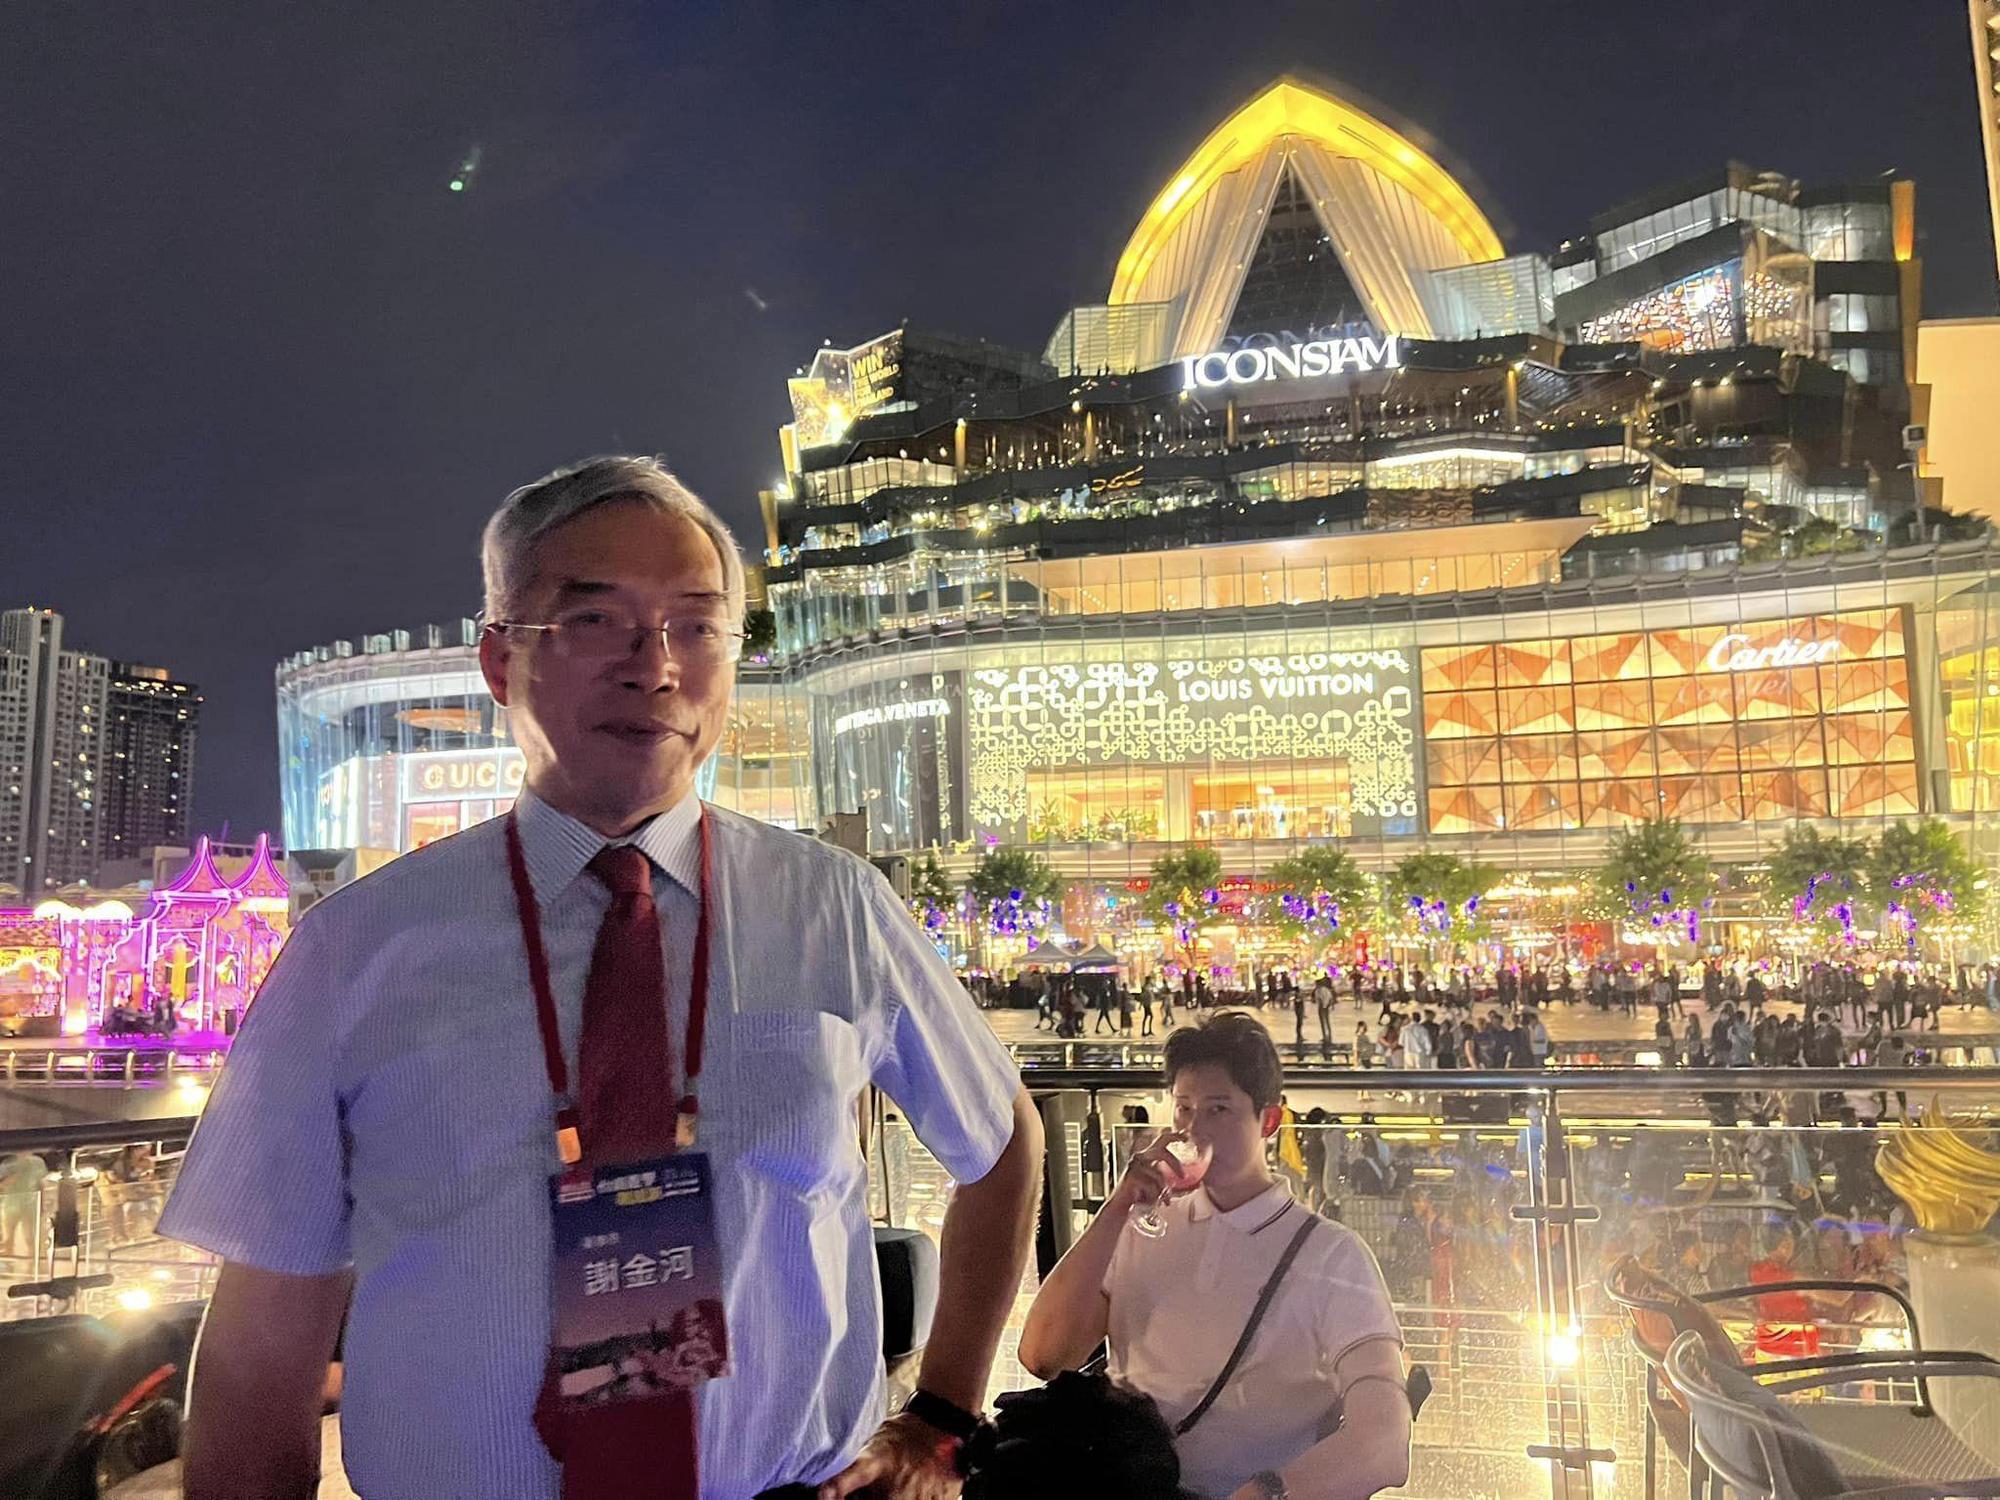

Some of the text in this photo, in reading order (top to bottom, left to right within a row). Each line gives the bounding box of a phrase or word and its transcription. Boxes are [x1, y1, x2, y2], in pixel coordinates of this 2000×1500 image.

[852, 353, 884, 379] WIN
[1182, 334, 1401, 389] ICONSIAM
[1707, 633, 1841, 671] Cartier
[1178, 672, 1374, 702] LOUIS VUITTON
[884, 699, 951, 722] VENETA
